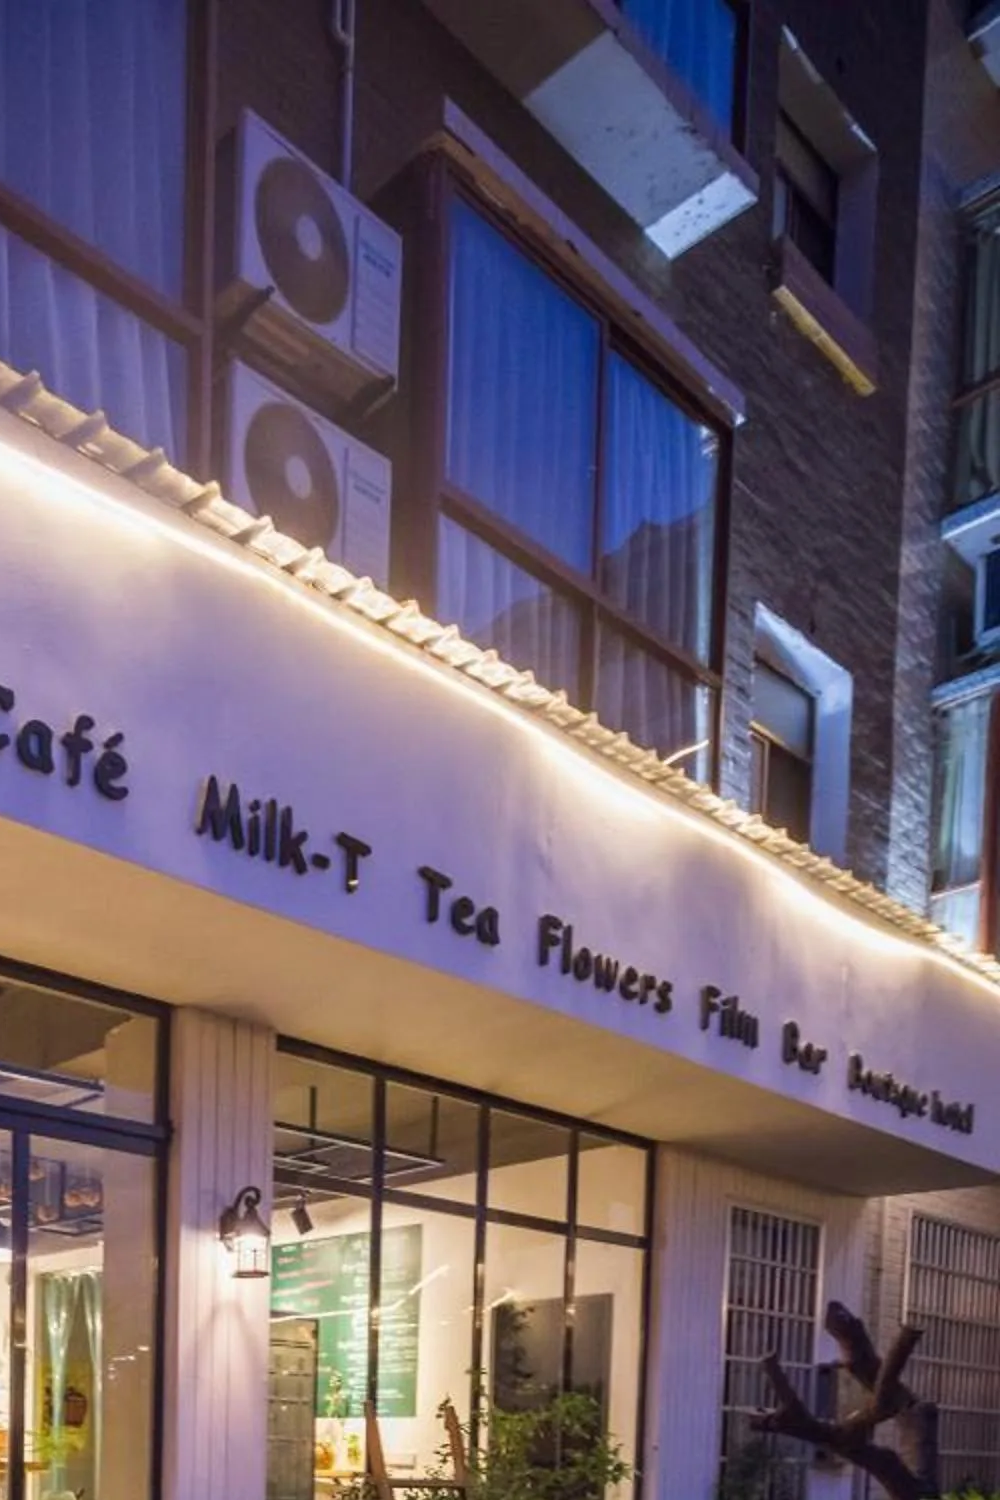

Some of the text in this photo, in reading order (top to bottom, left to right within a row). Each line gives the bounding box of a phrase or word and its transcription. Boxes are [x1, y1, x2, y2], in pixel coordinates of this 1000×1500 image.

[196, 775, 372, 893] Milk-T
[418, 865, 501, 947] Tea
[537, 913, 673, 1014] Flowers
[699, 984, 760, 1050] Film
[781, 1020, 828, 1076] Bar
